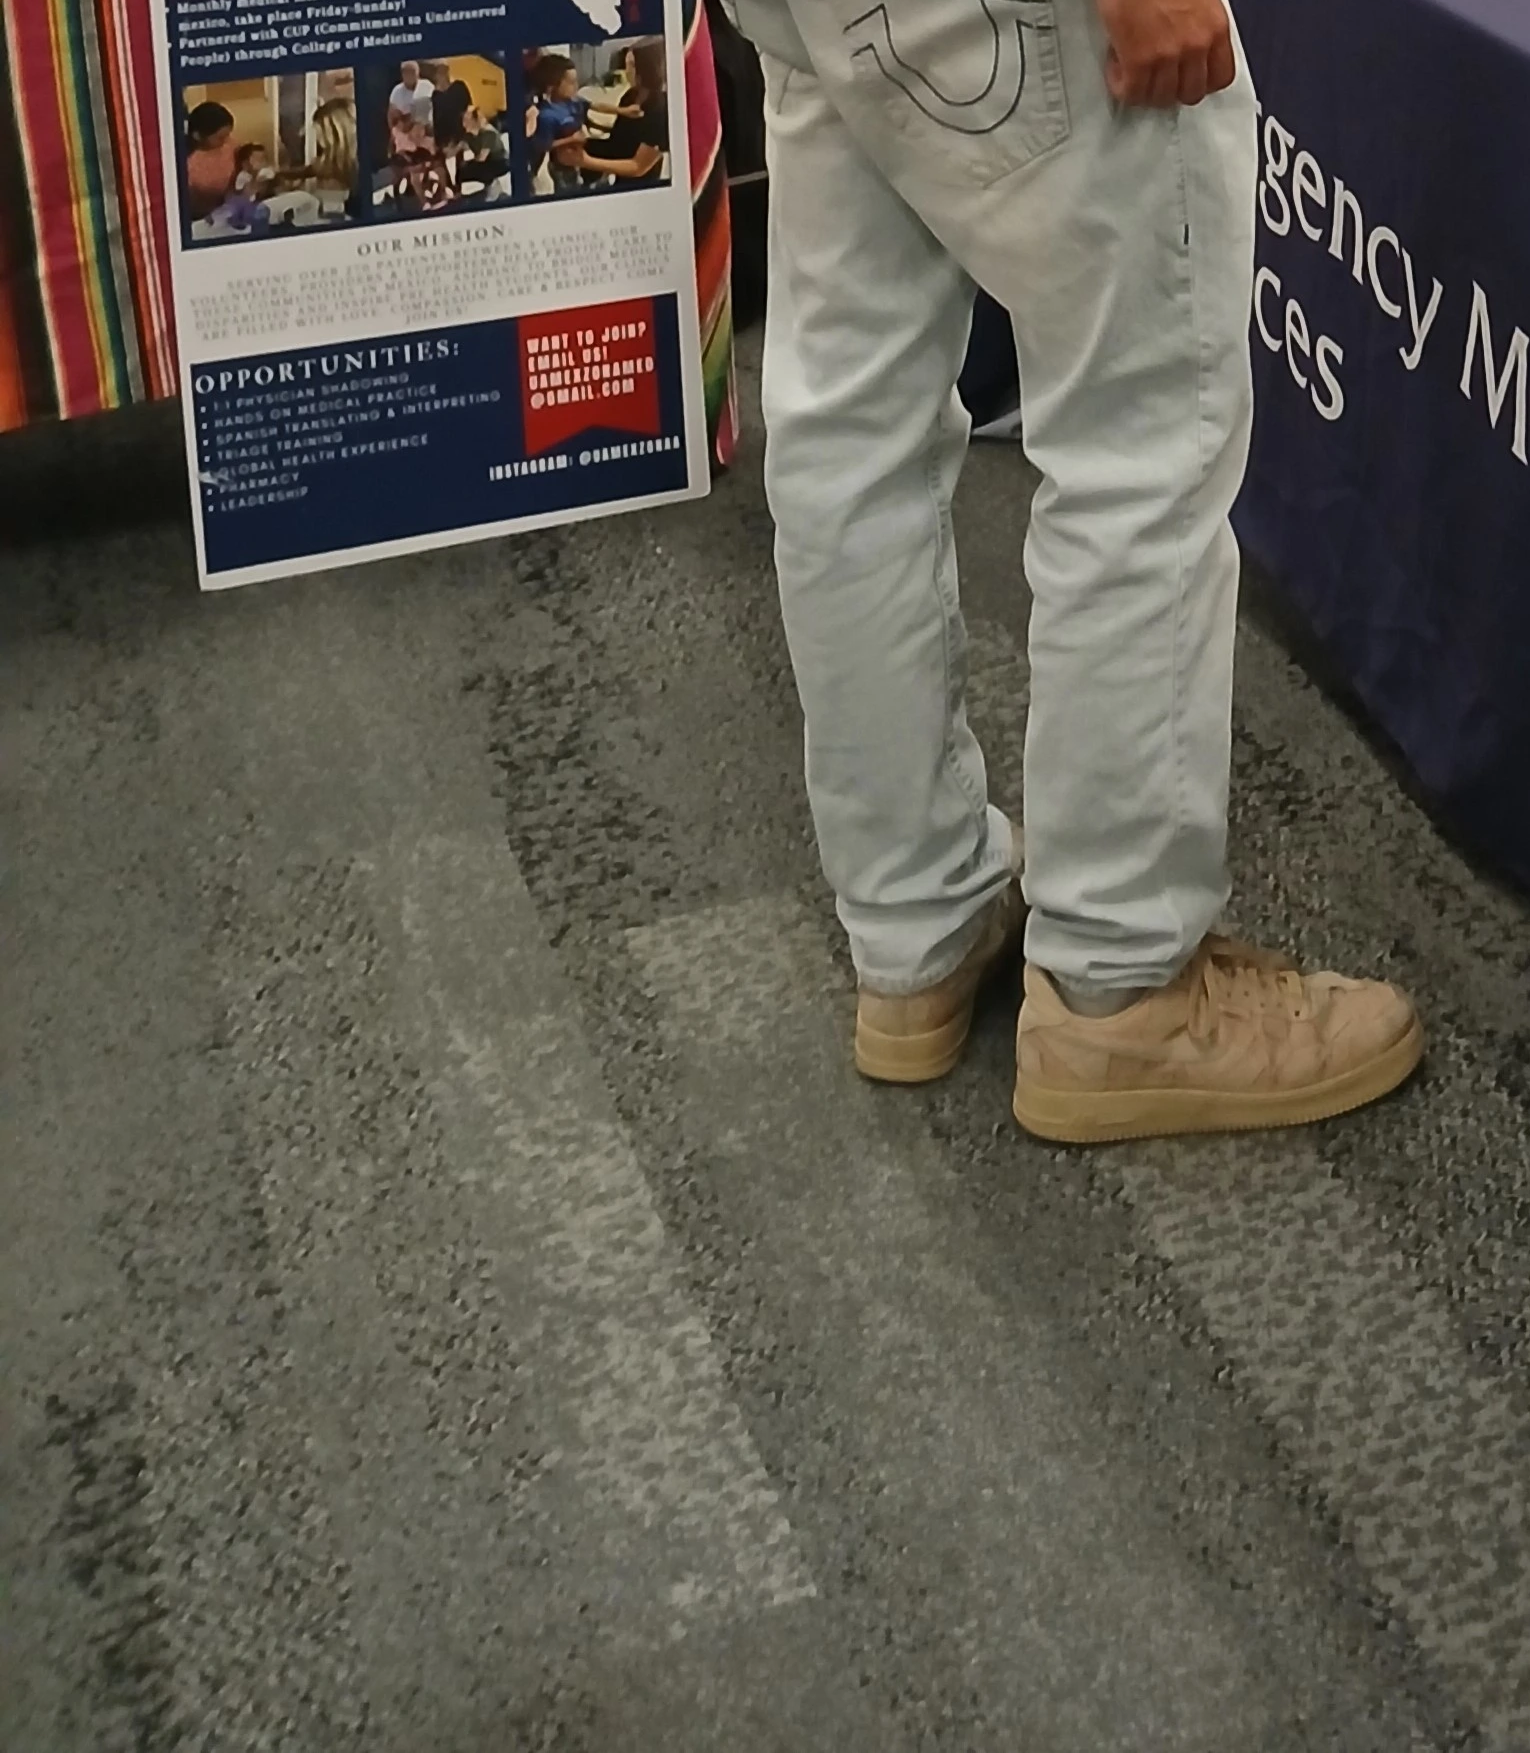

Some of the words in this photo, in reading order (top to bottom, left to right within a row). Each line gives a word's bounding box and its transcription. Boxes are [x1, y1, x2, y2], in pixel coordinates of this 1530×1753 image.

[179, 30, 246, 49] Partnered
[250, 28, 279, 41] with
[283, 24, 311, 38] CUP
[408, 15, 421, 25] to
[425, 4, 506, 24] Underserved
[234, 12, 263, 26] take
[267, 9, 302, 25] place
[180, 51, 231, 68] People)
[234, 44, 288, 62] through
[292, 39, 342, 57] College
[345, 37, 359, 49] of
[363, 31, 423, 48] Medicine
[356, 237, 403, 257] OUR
[526, 332, 569, 354] WANT
[576, 328, 594, 347] TO
[601, 321, 647, 343] JOIN?
[1254, 266, 1344, 421] ces
[195, 339, 459, 395] OPPORTUNITIES:
[527, 350, 575, 373] EMAIL
[582, 345, 608, 364] US!
[214, 411, 264, 429] HANDS
[269, 407, 292, 421] ON
[298, 398, 360, 415] MEDICAL
[367, 383, 437, 405] PRACTICE
[236, 388, 315, 409] PHYSICIAN
[321, 372, 409, 395] SHADOWING
[216, 426, 278, 447] SPANISH
[284, 408, 380, 434] TRANSLATING
[402, 389, 501, 415] INTERPRETING
[217, 443, 269, 461] TRIAGE
[276, 431, 343, 452] TRAINING
[282, 449, 336, 467] HEALTH
[341, 432, 428, 459] EXPERIENCE
[219, 471, 299, 494] PHARMACY
[220, 485, 308, 512] LEADERSHIP
